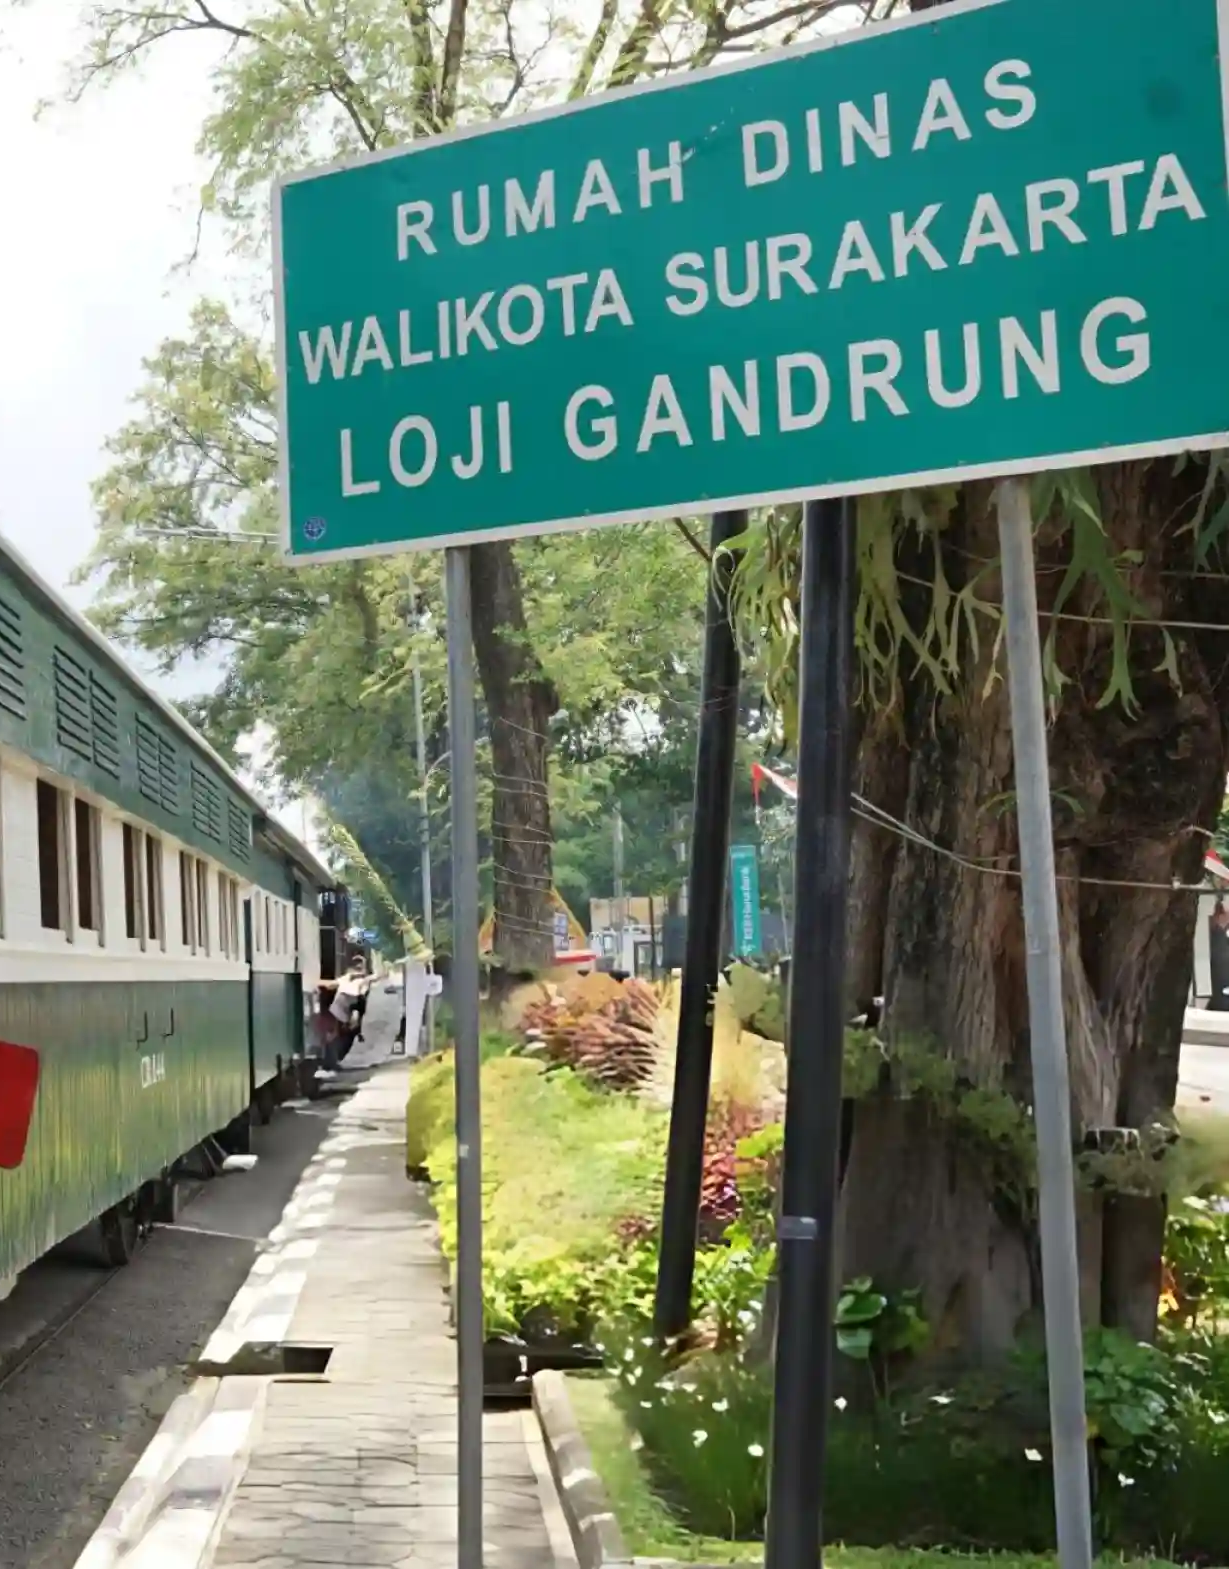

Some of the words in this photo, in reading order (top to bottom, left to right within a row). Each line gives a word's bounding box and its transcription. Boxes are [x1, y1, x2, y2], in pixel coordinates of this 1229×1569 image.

[397, 141, 684, 261] RUMAH
[742, 59, 1036, 186] DINAS
[299, 269, 633, 384] WALIKOTA
[666, 153, 1206, 316] SURAKARTA
[341, 401, 512, 497] LOJI
[564, 297, 1151, 461] GANDRUNG
